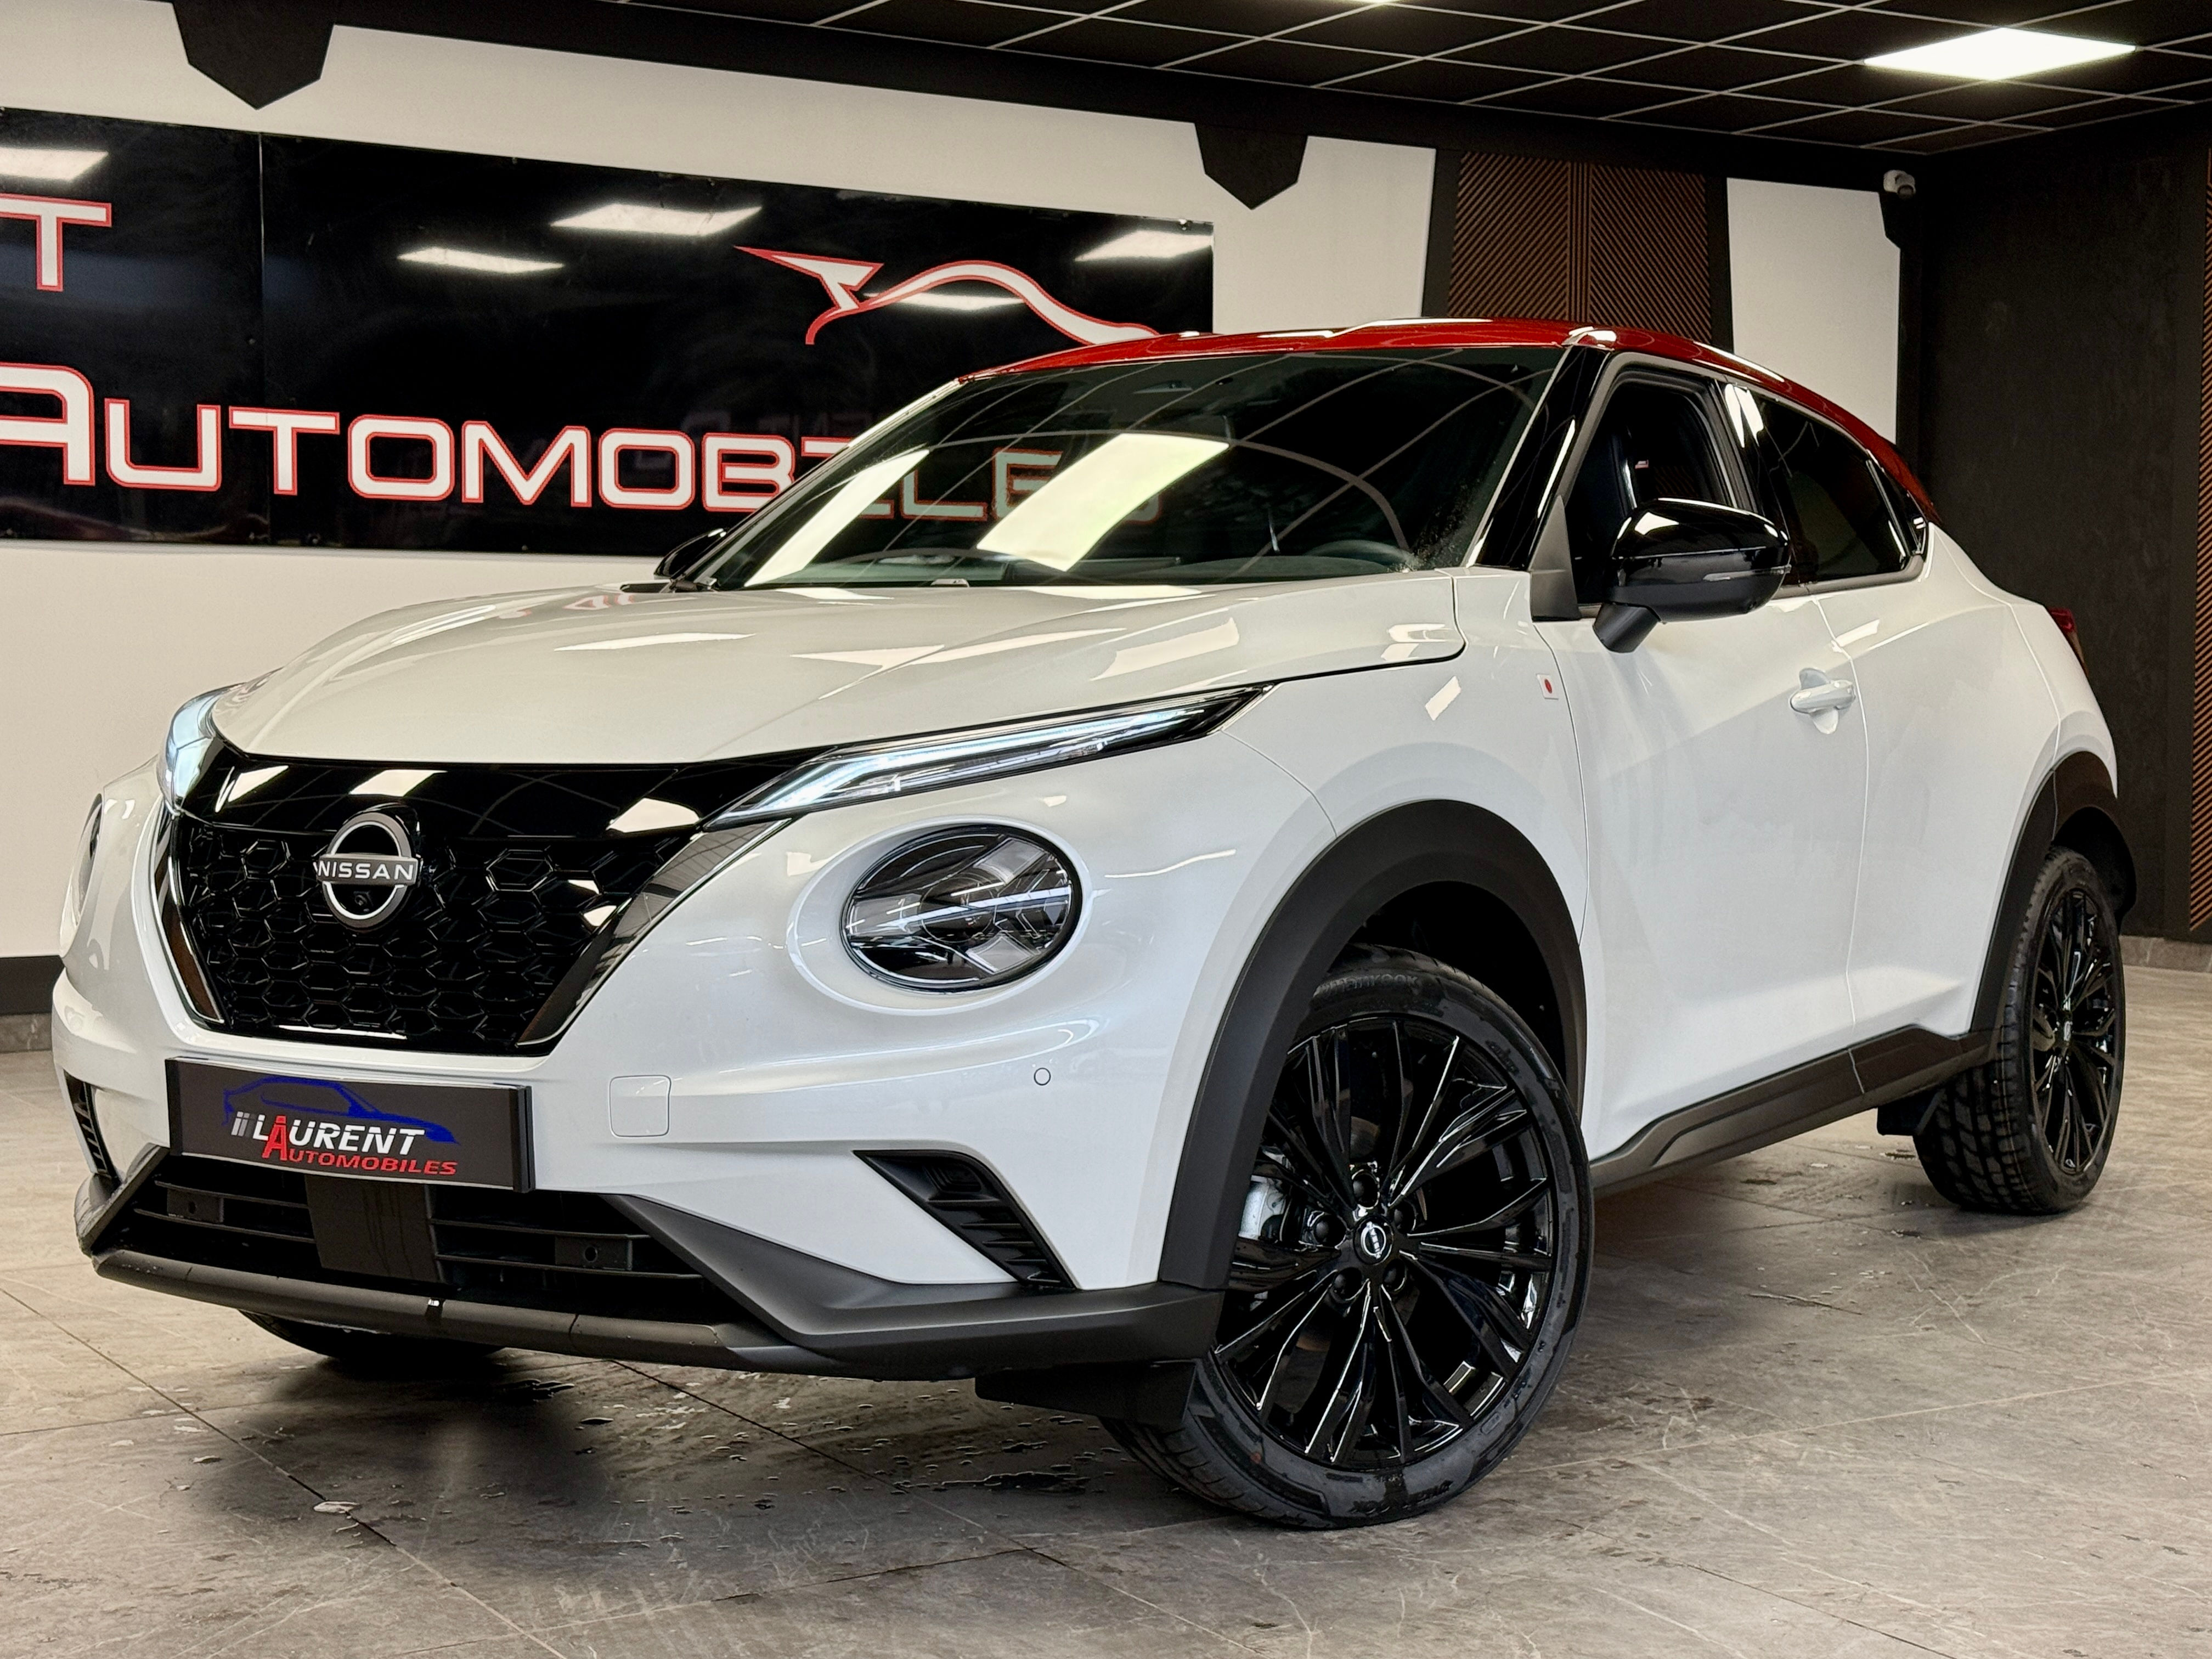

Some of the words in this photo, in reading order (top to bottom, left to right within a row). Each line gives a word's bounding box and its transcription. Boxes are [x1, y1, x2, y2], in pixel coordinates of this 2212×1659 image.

[0, 362, 1161, 525] AUTOMOBLE
[313, 860, 414, 880] NISSAN
[252, 1115, 425, 1160] LAURENT
